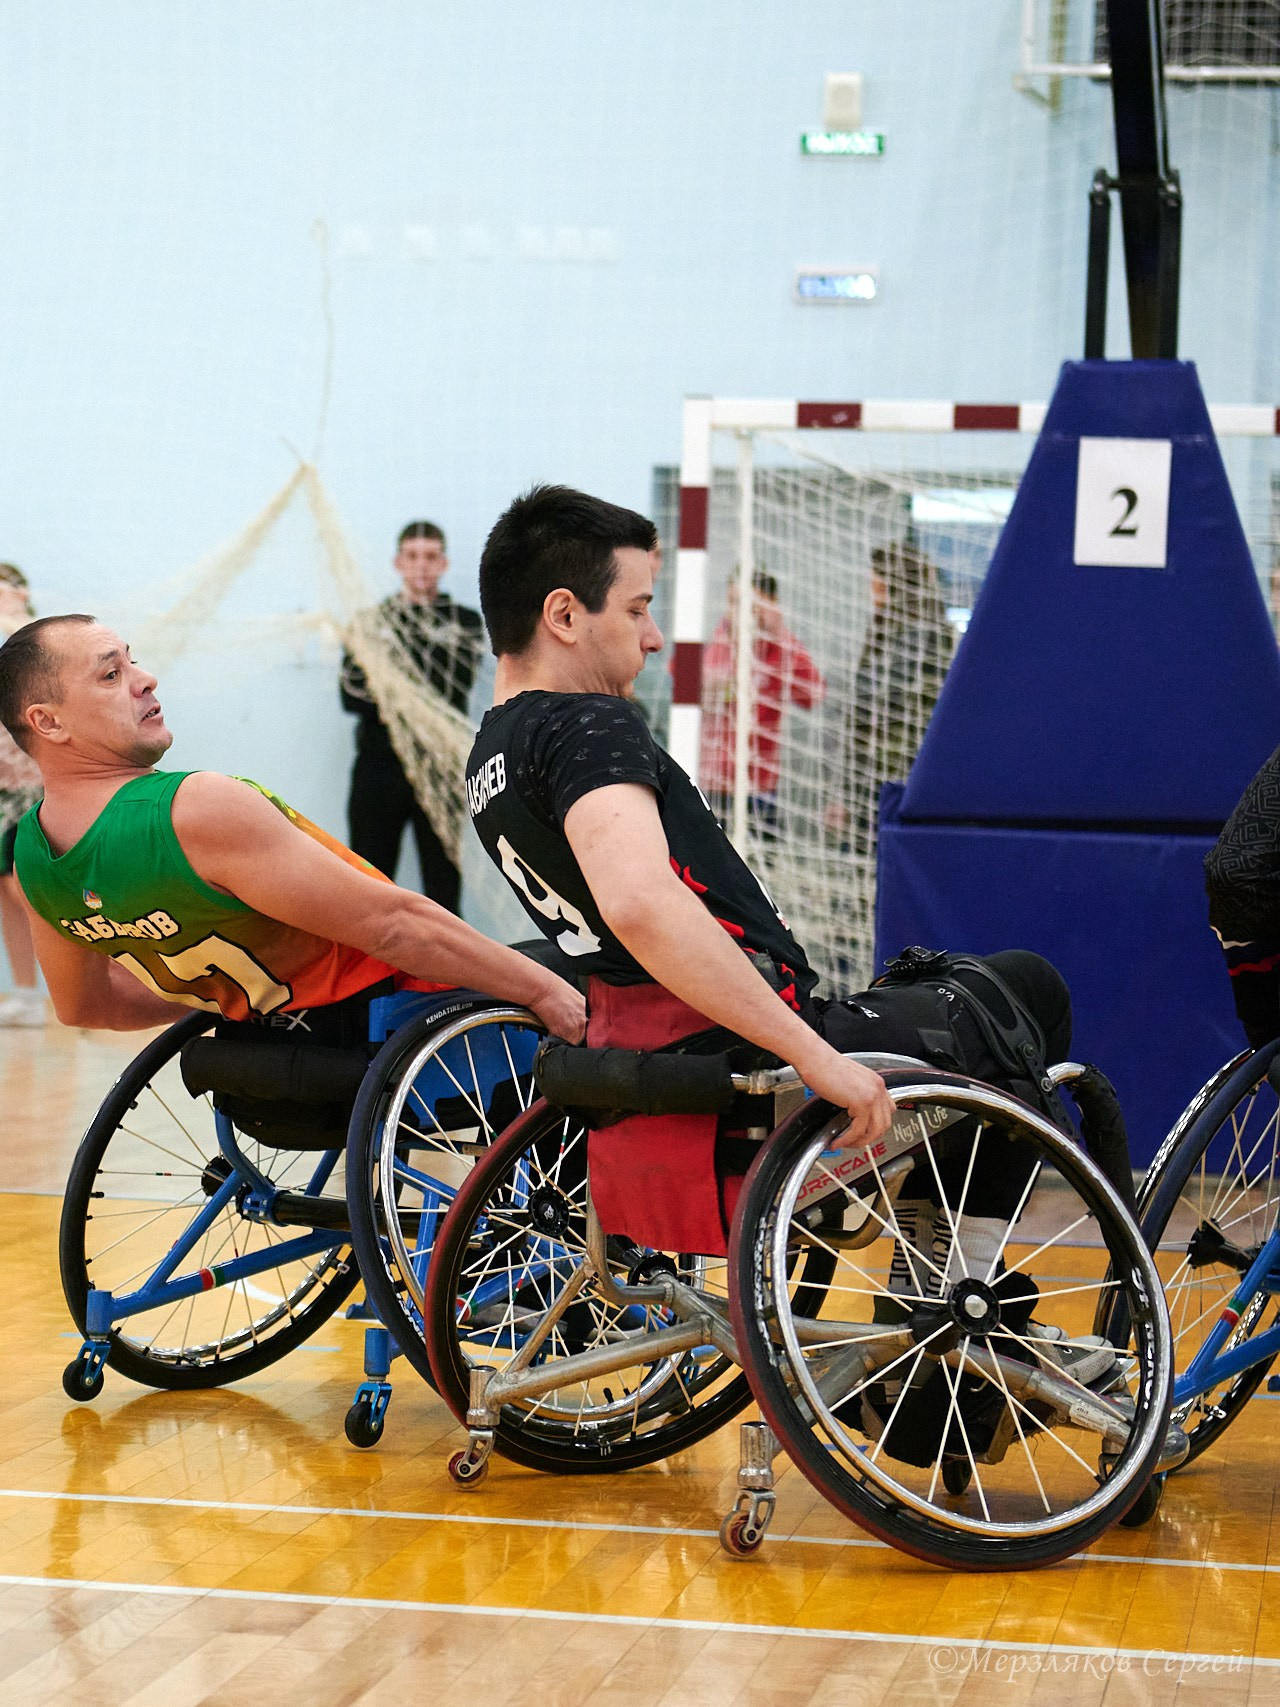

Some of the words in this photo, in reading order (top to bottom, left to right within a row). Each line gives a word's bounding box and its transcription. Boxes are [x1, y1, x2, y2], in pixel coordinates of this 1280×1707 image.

[1109, 485, 1138, 537] 2
[893, 1117, 923, 1143] Nigh
[924, 1105, 948, 1128] Life
